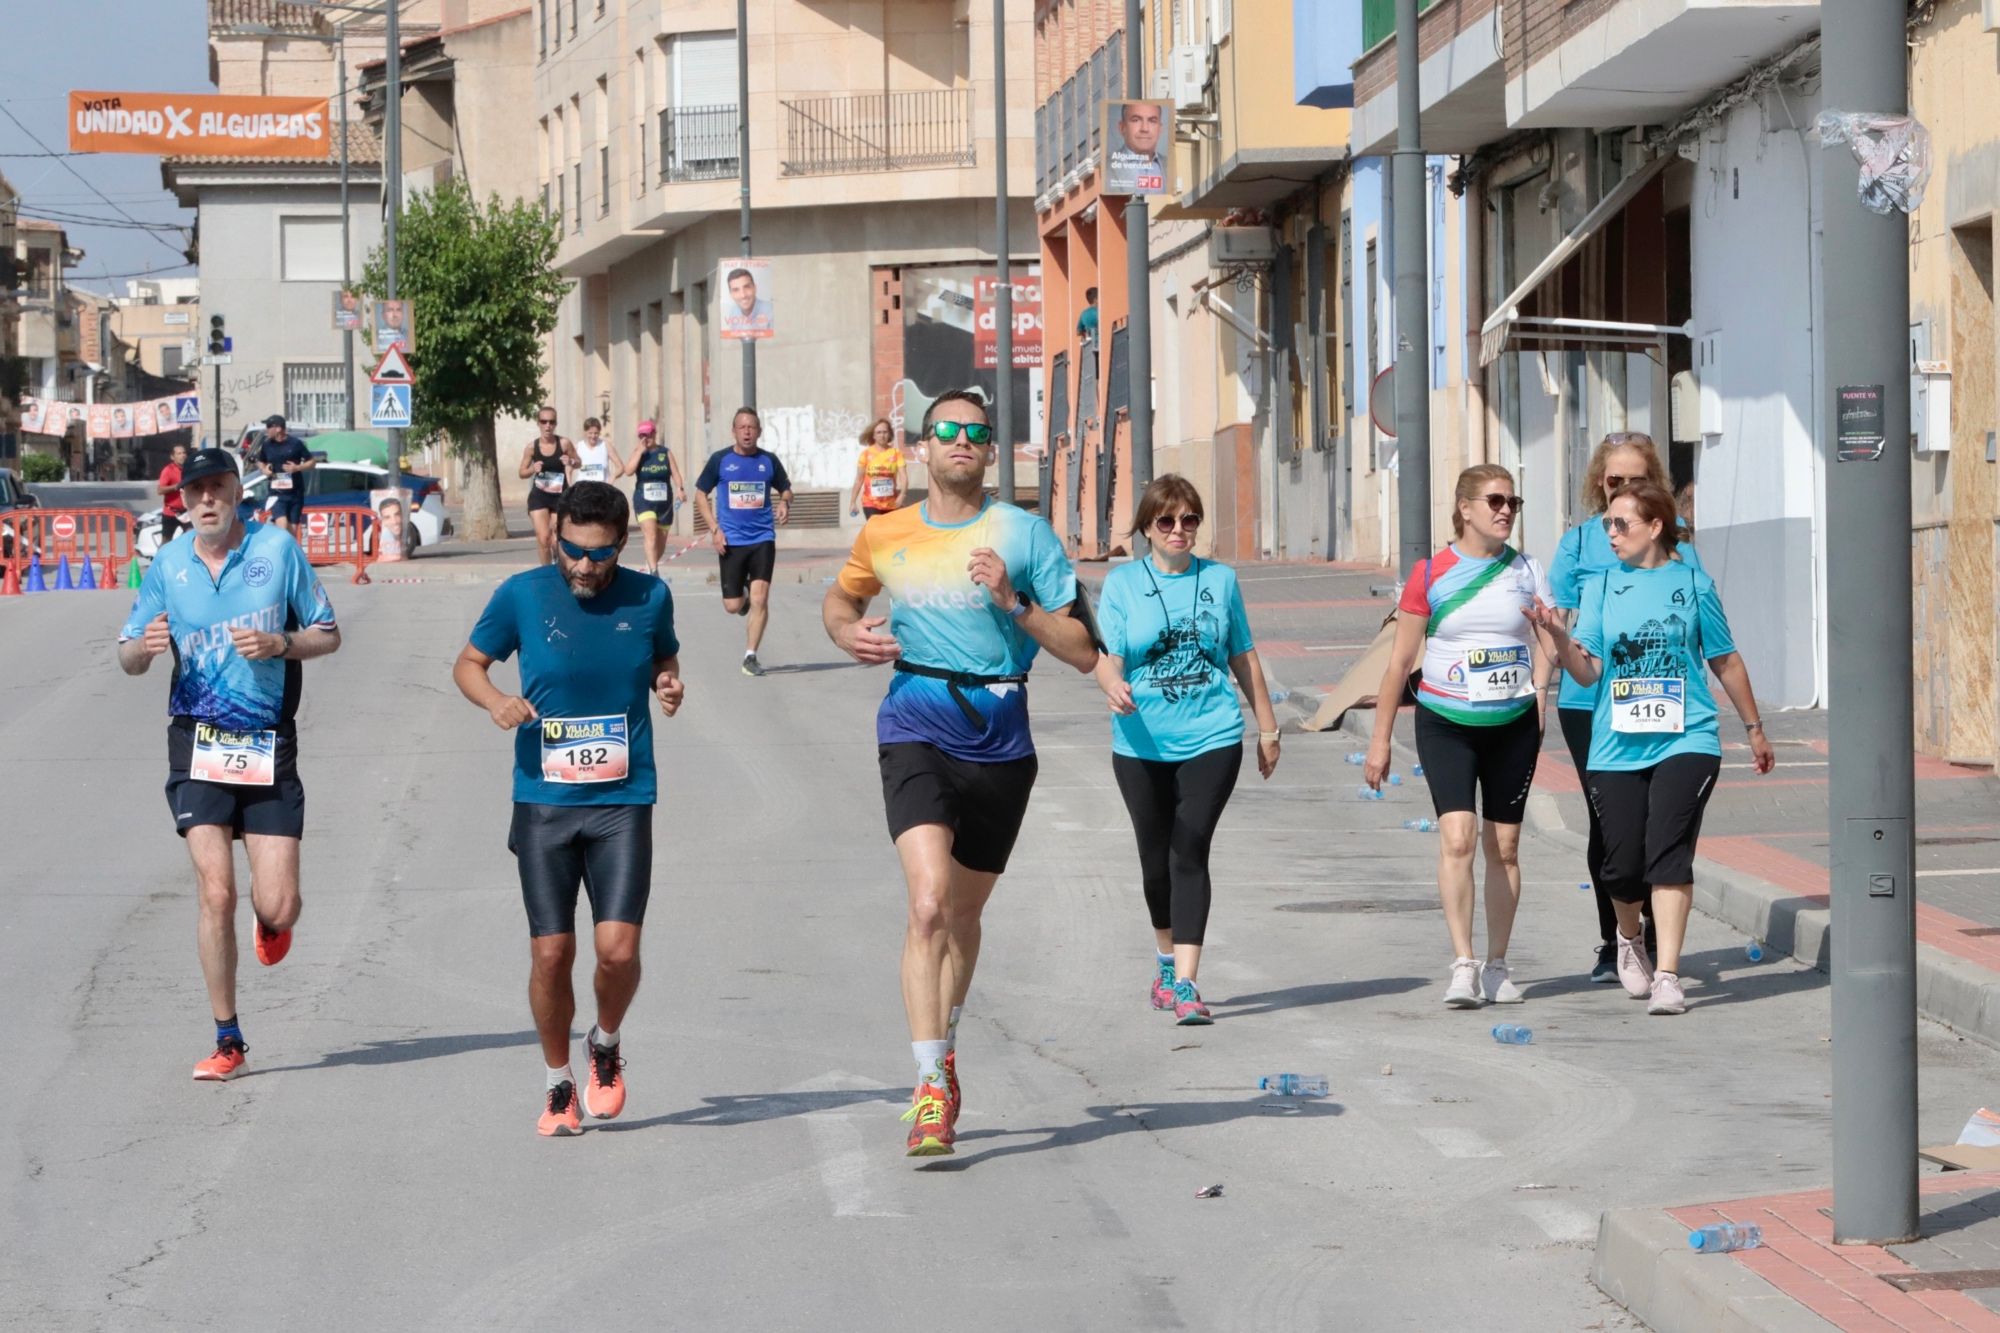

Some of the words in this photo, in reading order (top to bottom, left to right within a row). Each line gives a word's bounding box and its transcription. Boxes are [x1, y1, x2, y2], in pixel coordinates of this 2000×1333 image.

[84, 98, 121, 112] VOTA
[77, 110, 163, 135] UNIDAD
[164, 105, 193, 139] X
[199, 111, 323, 140] ALGUAZAS
[250, 565, 266, 577] SR
[1488, 670, 1518, 685] 441
[1630, 703, 1666, 718] 416
[223, 753, 247, 769] 75
[565, 748, 608, 766] 182
